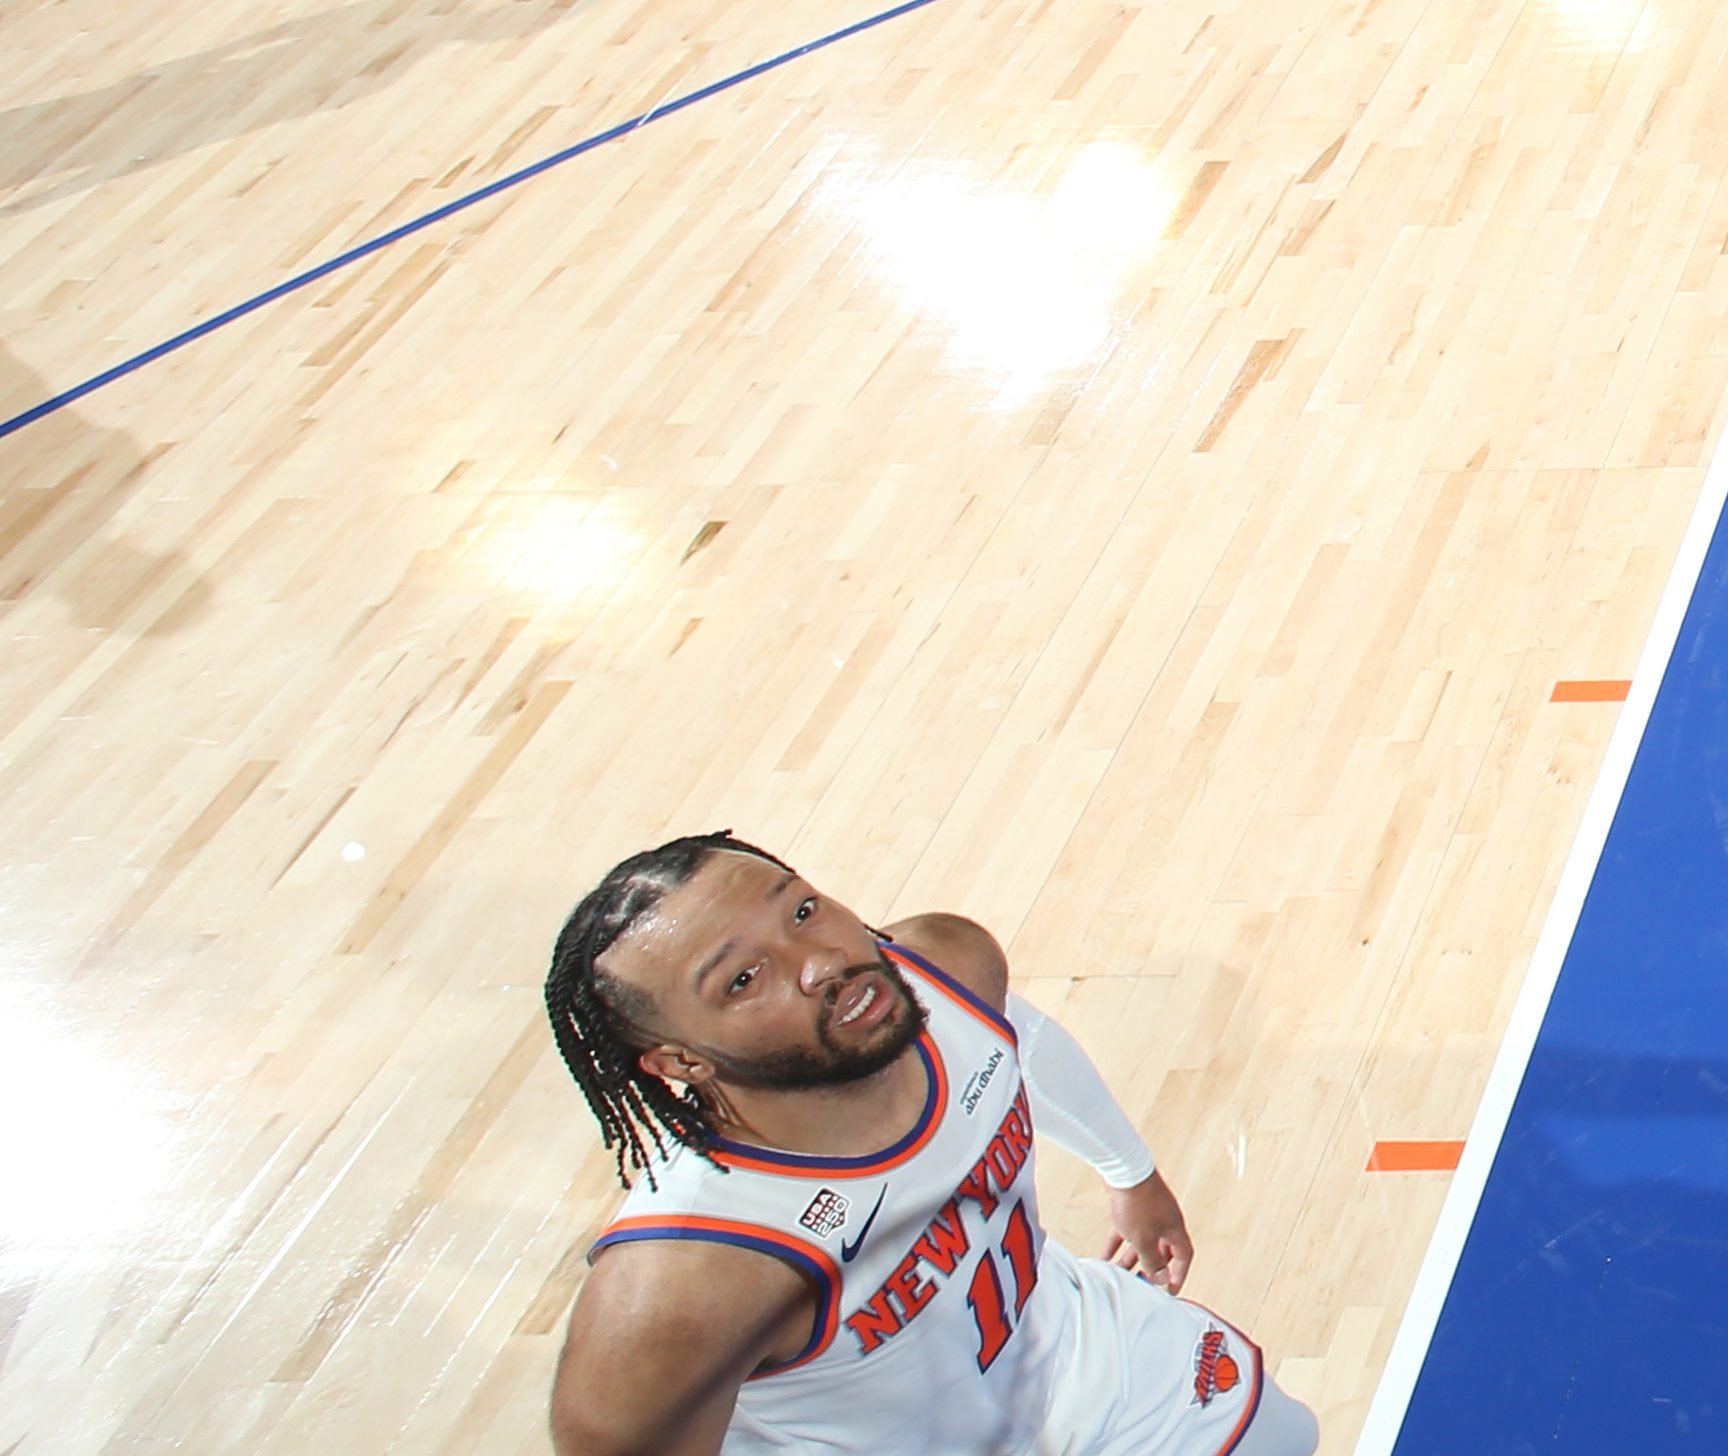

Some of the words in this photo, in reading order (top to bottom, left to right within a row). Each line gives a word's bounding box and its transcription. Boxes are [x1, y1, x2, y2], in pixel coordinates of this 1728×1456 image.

[802, 1194, 833, 1226] USA
[817, 1198, 848, 1235] 250
[845, 1196, 970, 1357] NEW
[967, 1197, 1039, 1376] 11
